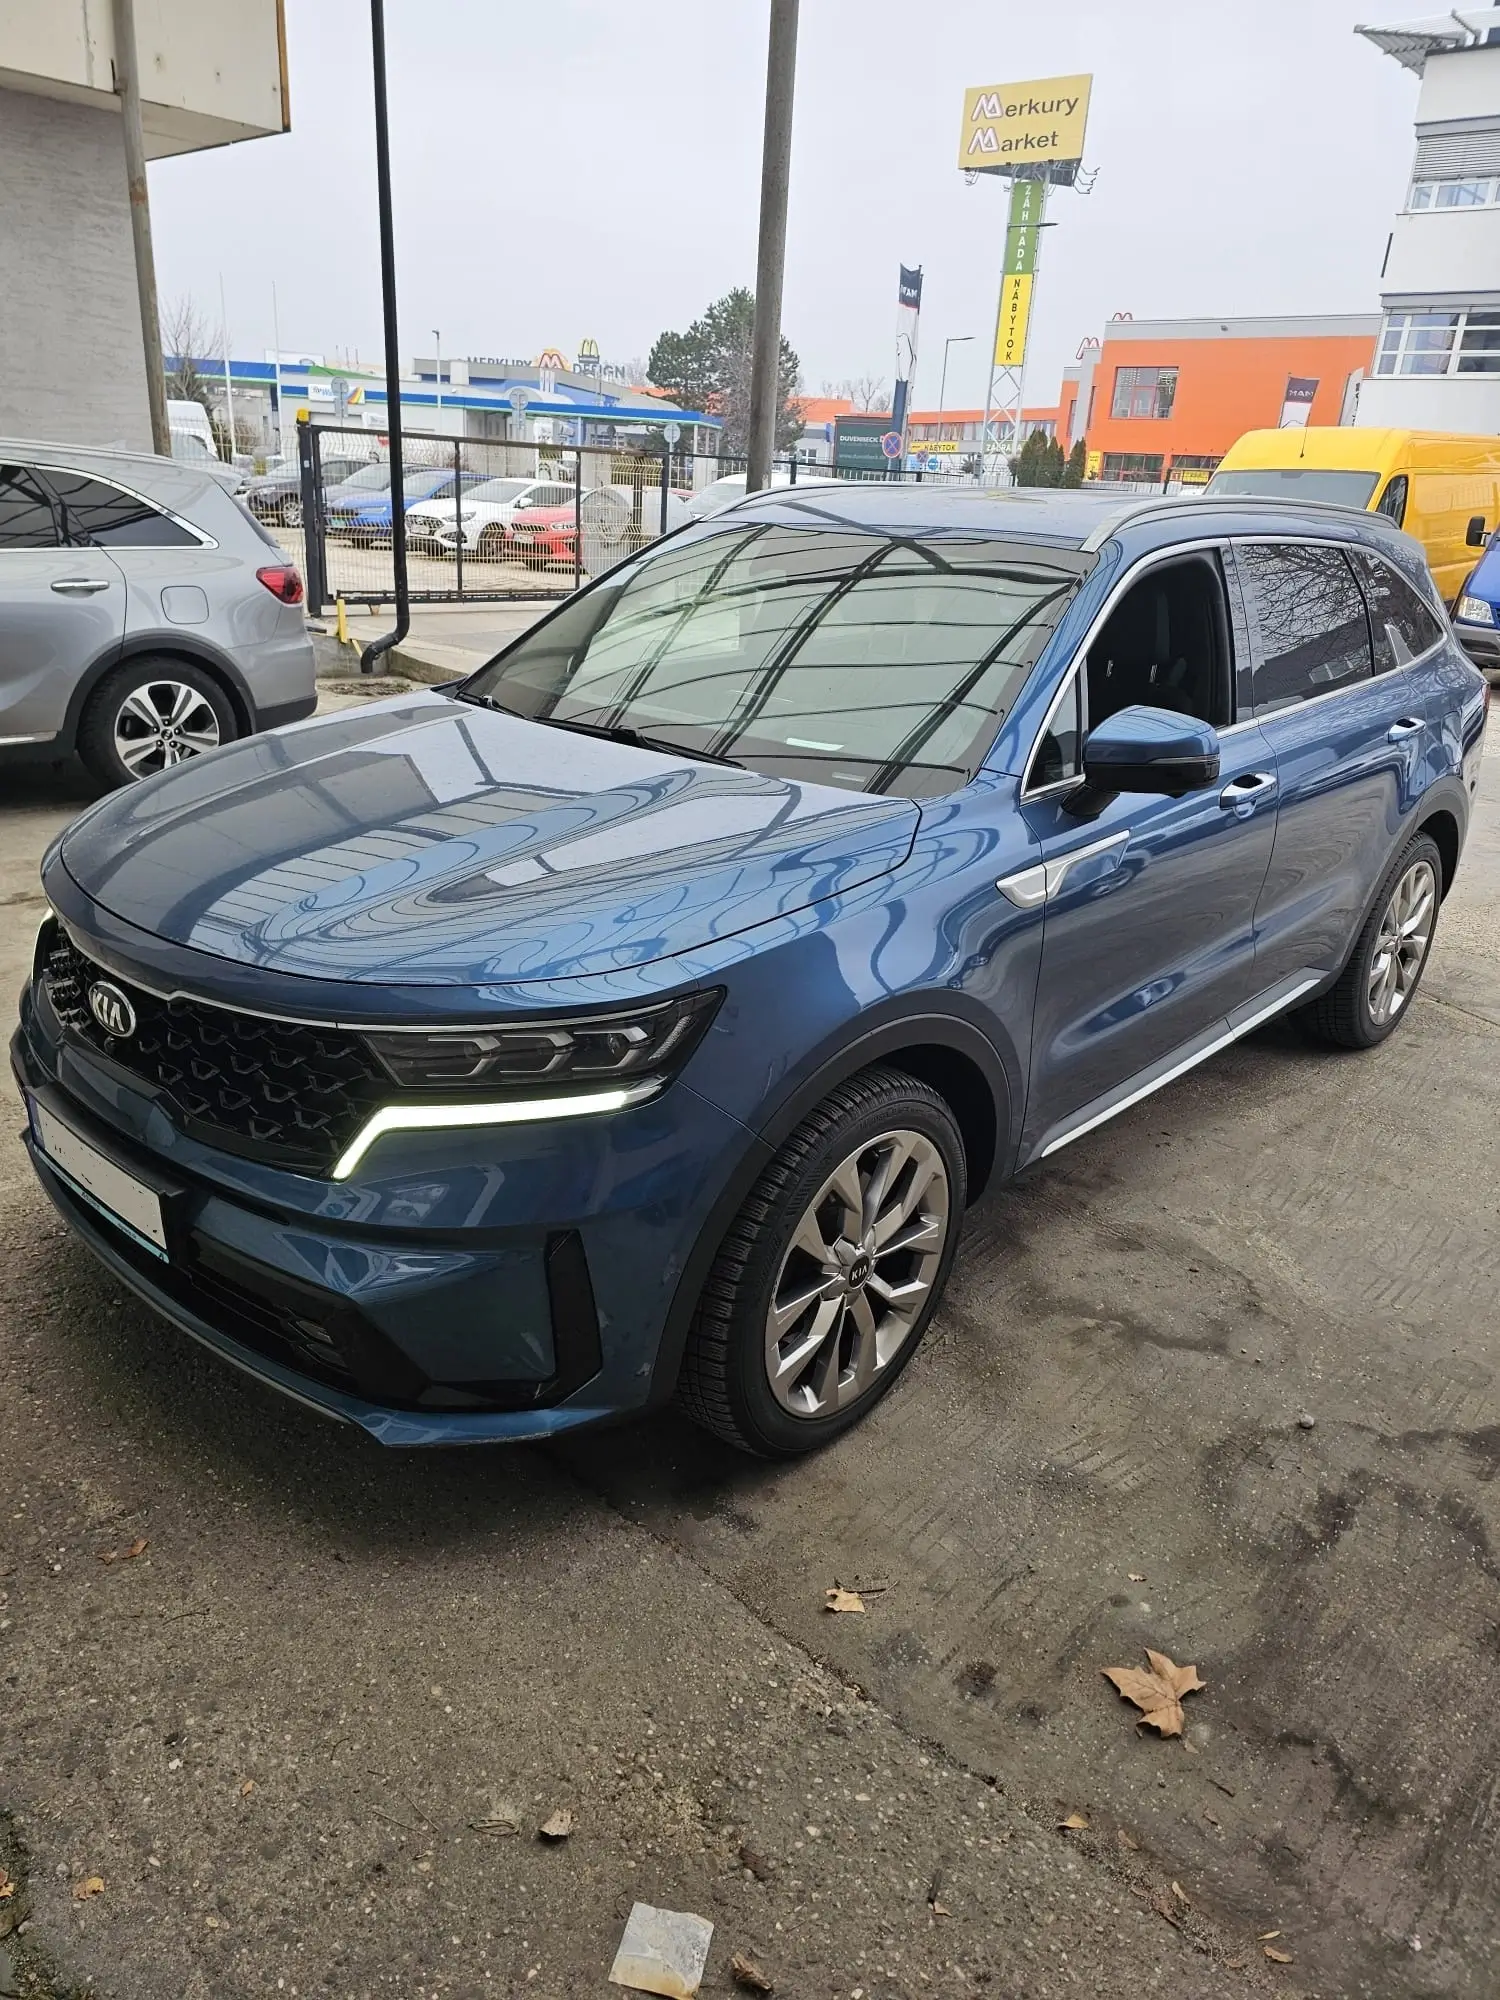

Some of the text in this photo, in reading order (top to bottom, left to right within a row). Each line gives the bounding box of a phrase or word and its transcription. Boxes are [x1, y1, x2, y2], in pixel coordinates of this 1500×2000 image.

[971, 92, 1079, 121] Merkury
[967, 126, 1059, 155] Market
[1005, 279, 1021, 361] NÁBYTOK
[92, 988, 125, 1032] KIA
[852, 1264, 868, 1281] KIA
